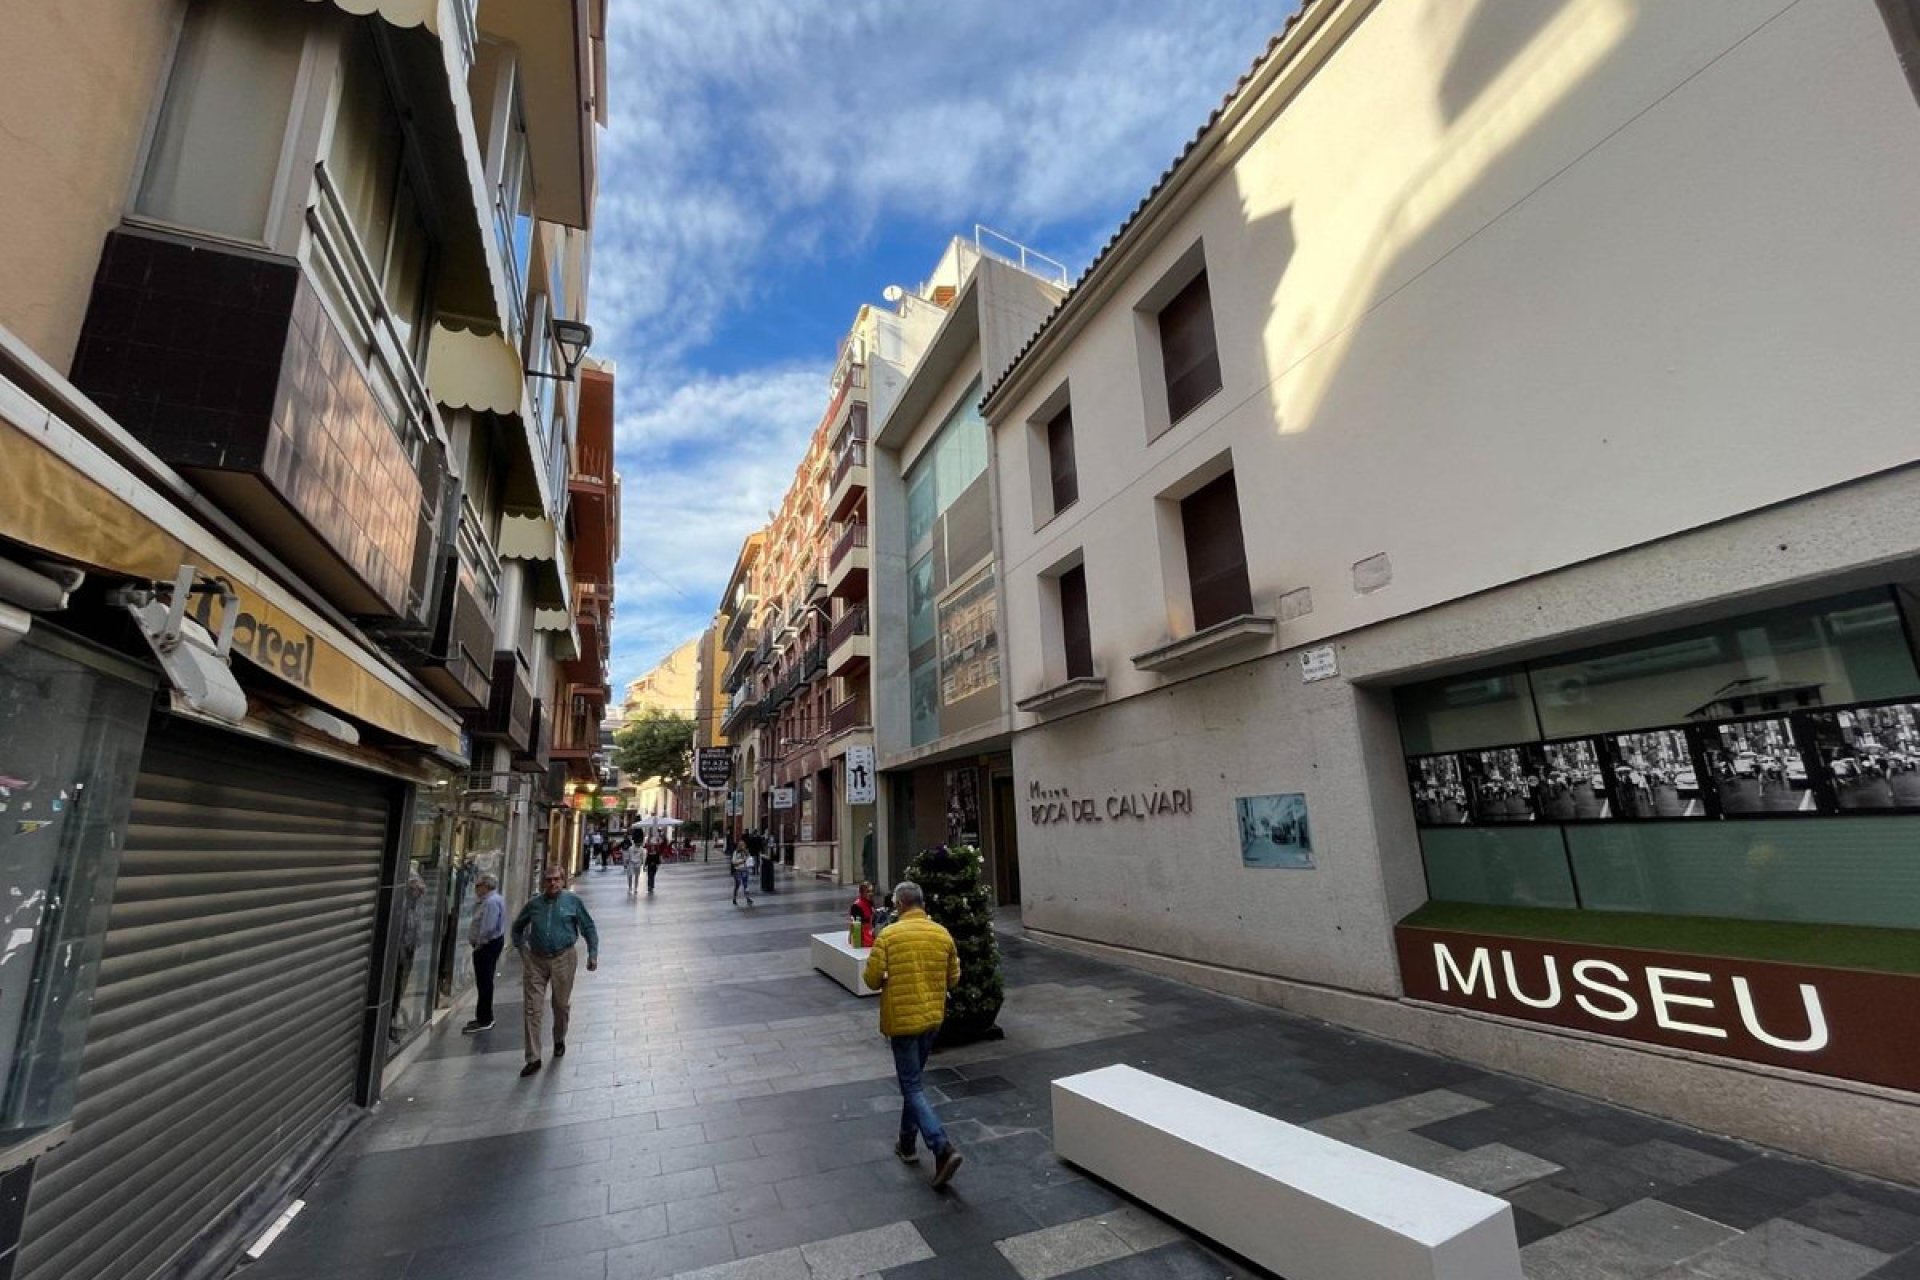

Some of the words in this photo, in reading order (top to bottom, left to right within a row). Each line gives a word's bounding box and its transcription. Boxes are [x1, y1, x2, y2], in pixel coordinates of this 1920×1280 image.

[1031, 802, 1069, 825] BOCA
[1072, 799, 1102, 822] DEL
[1106, 788, 1193, 819] CALVARI
[1433, 942, 1829, 1052] MUSEU
